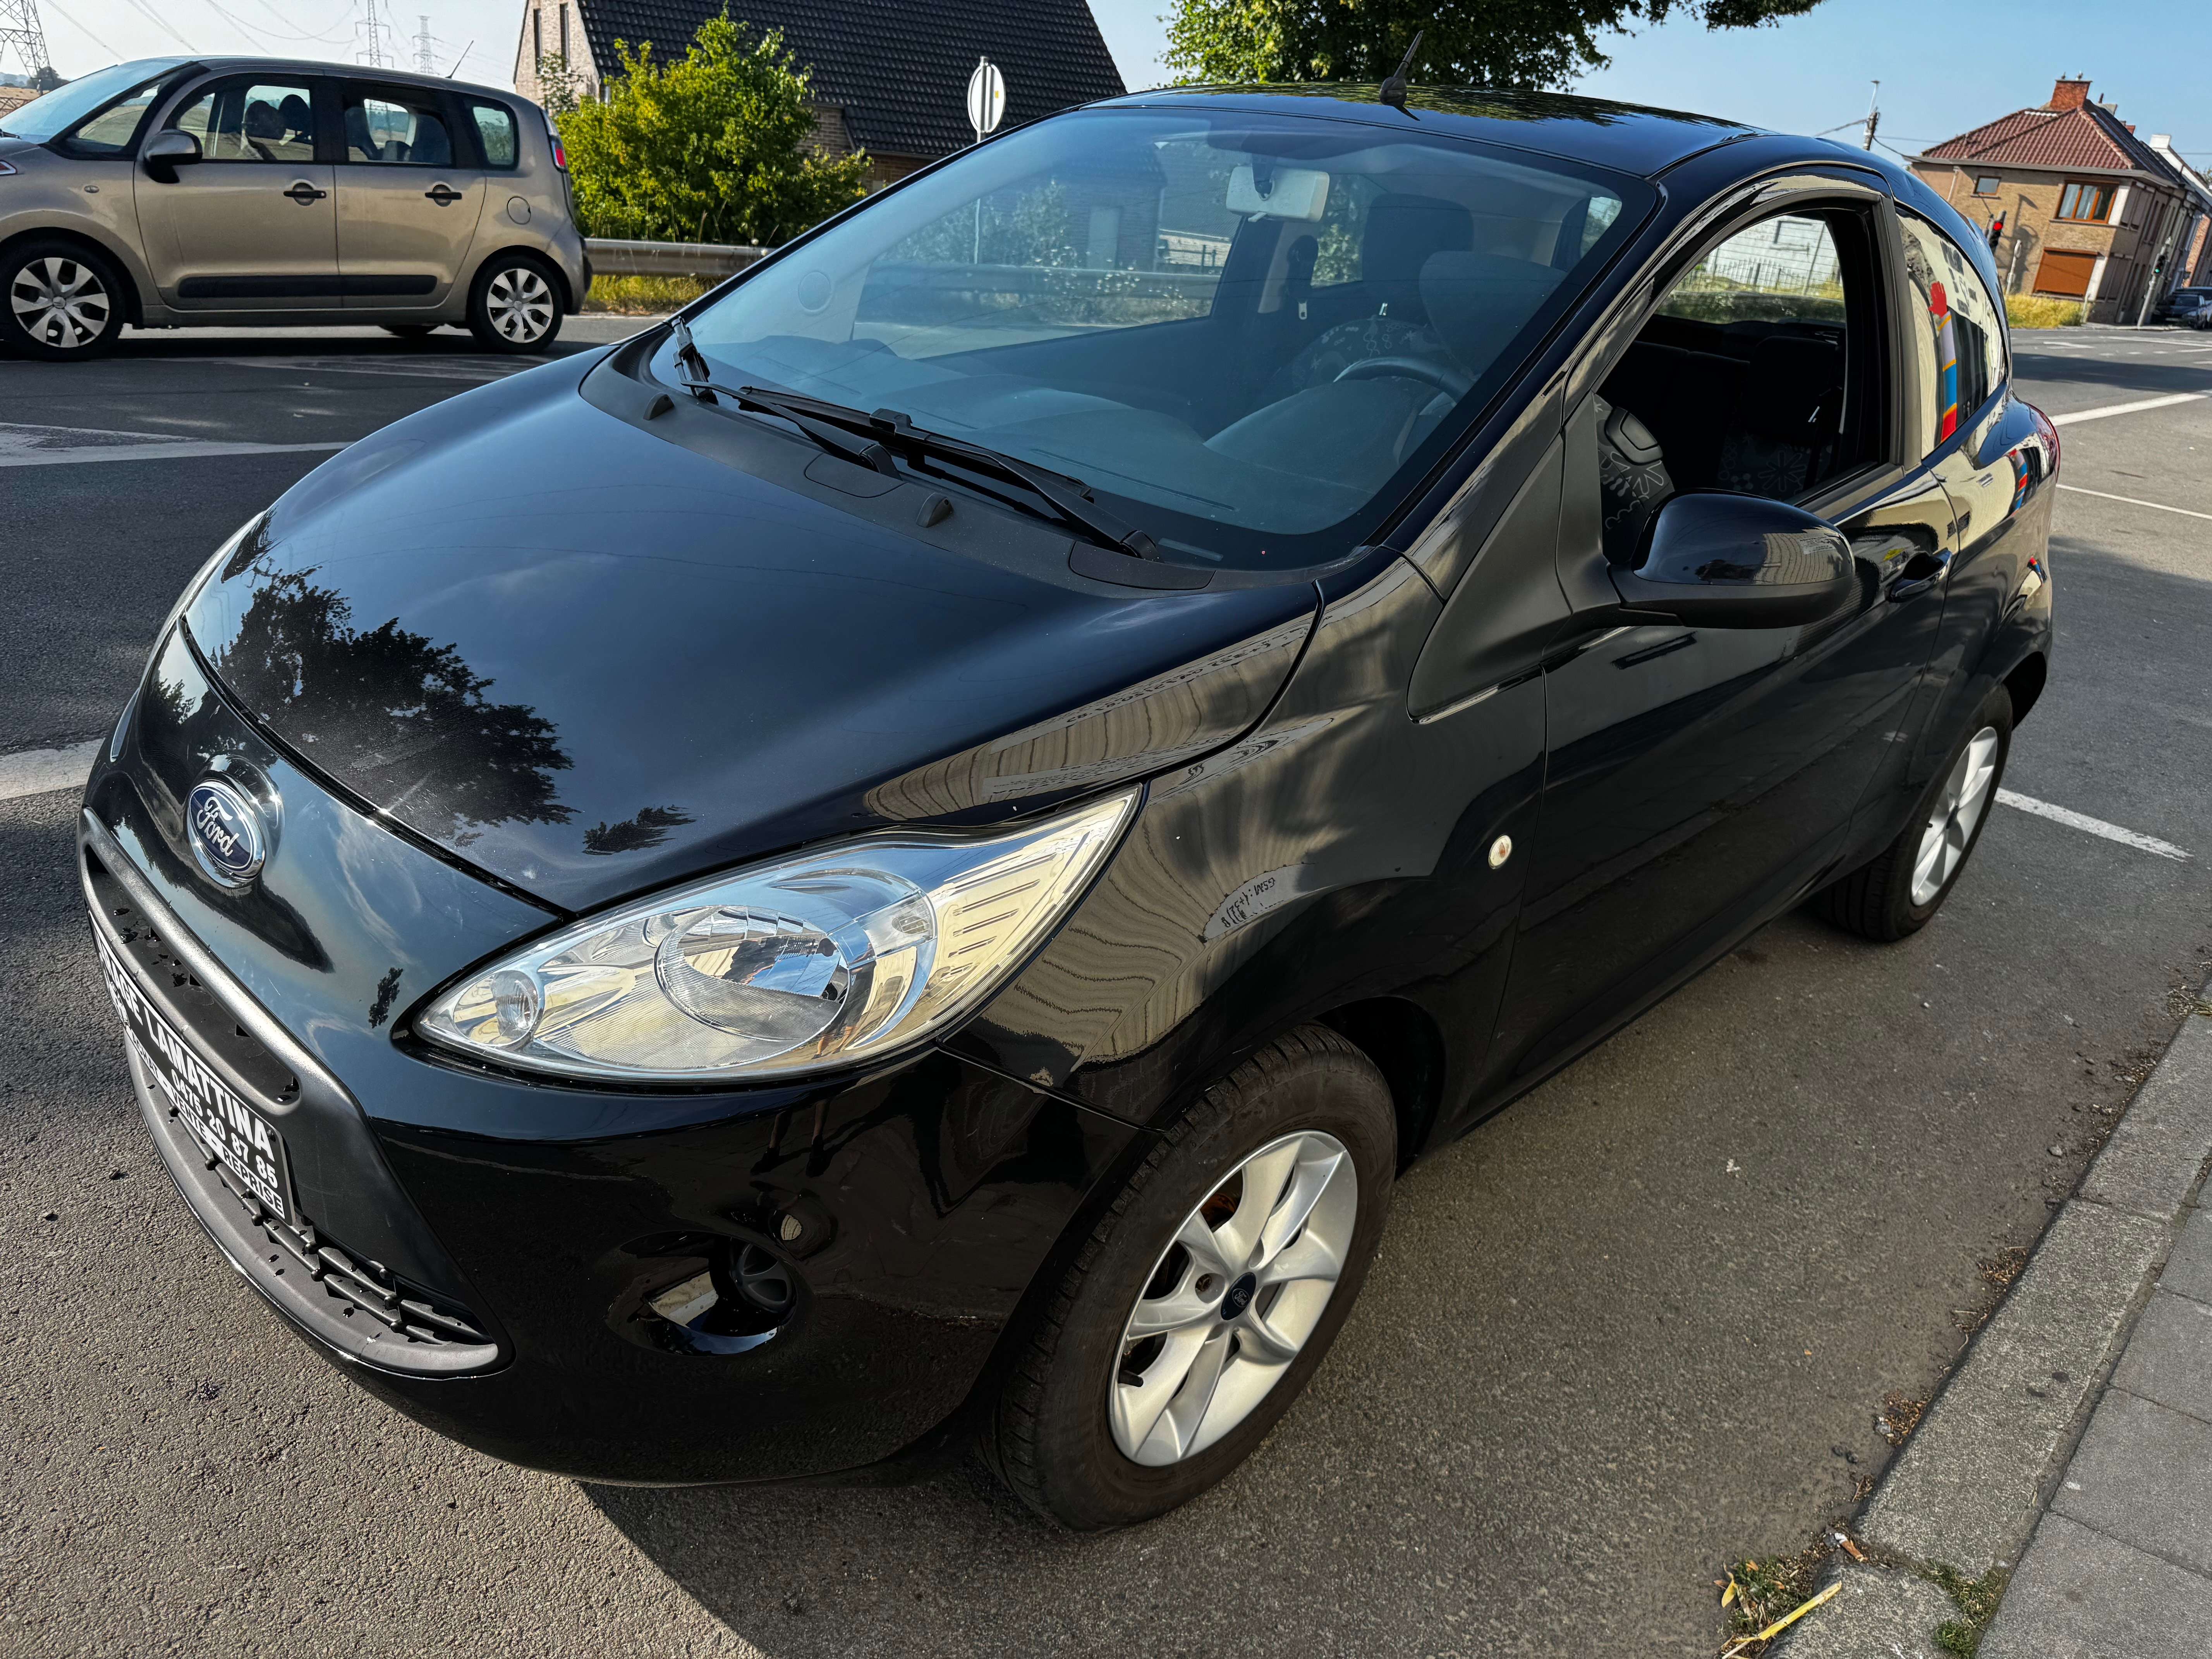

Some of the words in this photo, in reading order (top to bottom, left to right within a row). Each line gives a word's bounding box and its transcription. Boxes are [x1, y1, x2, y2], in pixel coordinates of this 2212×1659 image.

[197, 796, 240, 857] Ford
[94, 926, 143, 1025] RAGE
[144, 1006, 275, 1162] LAMATTINA
[131, 1031, 159, 1079] ACHAT
[170, 1087, 207, 1139] VENTE
[222, 1146, 284, 1215] REPRISE
[171, 1068, 203, 1117] 0475
[206, 1108, 226, 1141] 20
[231, 1132, 249, 1163] 87
[255, 1154, 278, 1188] 85
[1234, 1290, 1247, 1306] Ford
